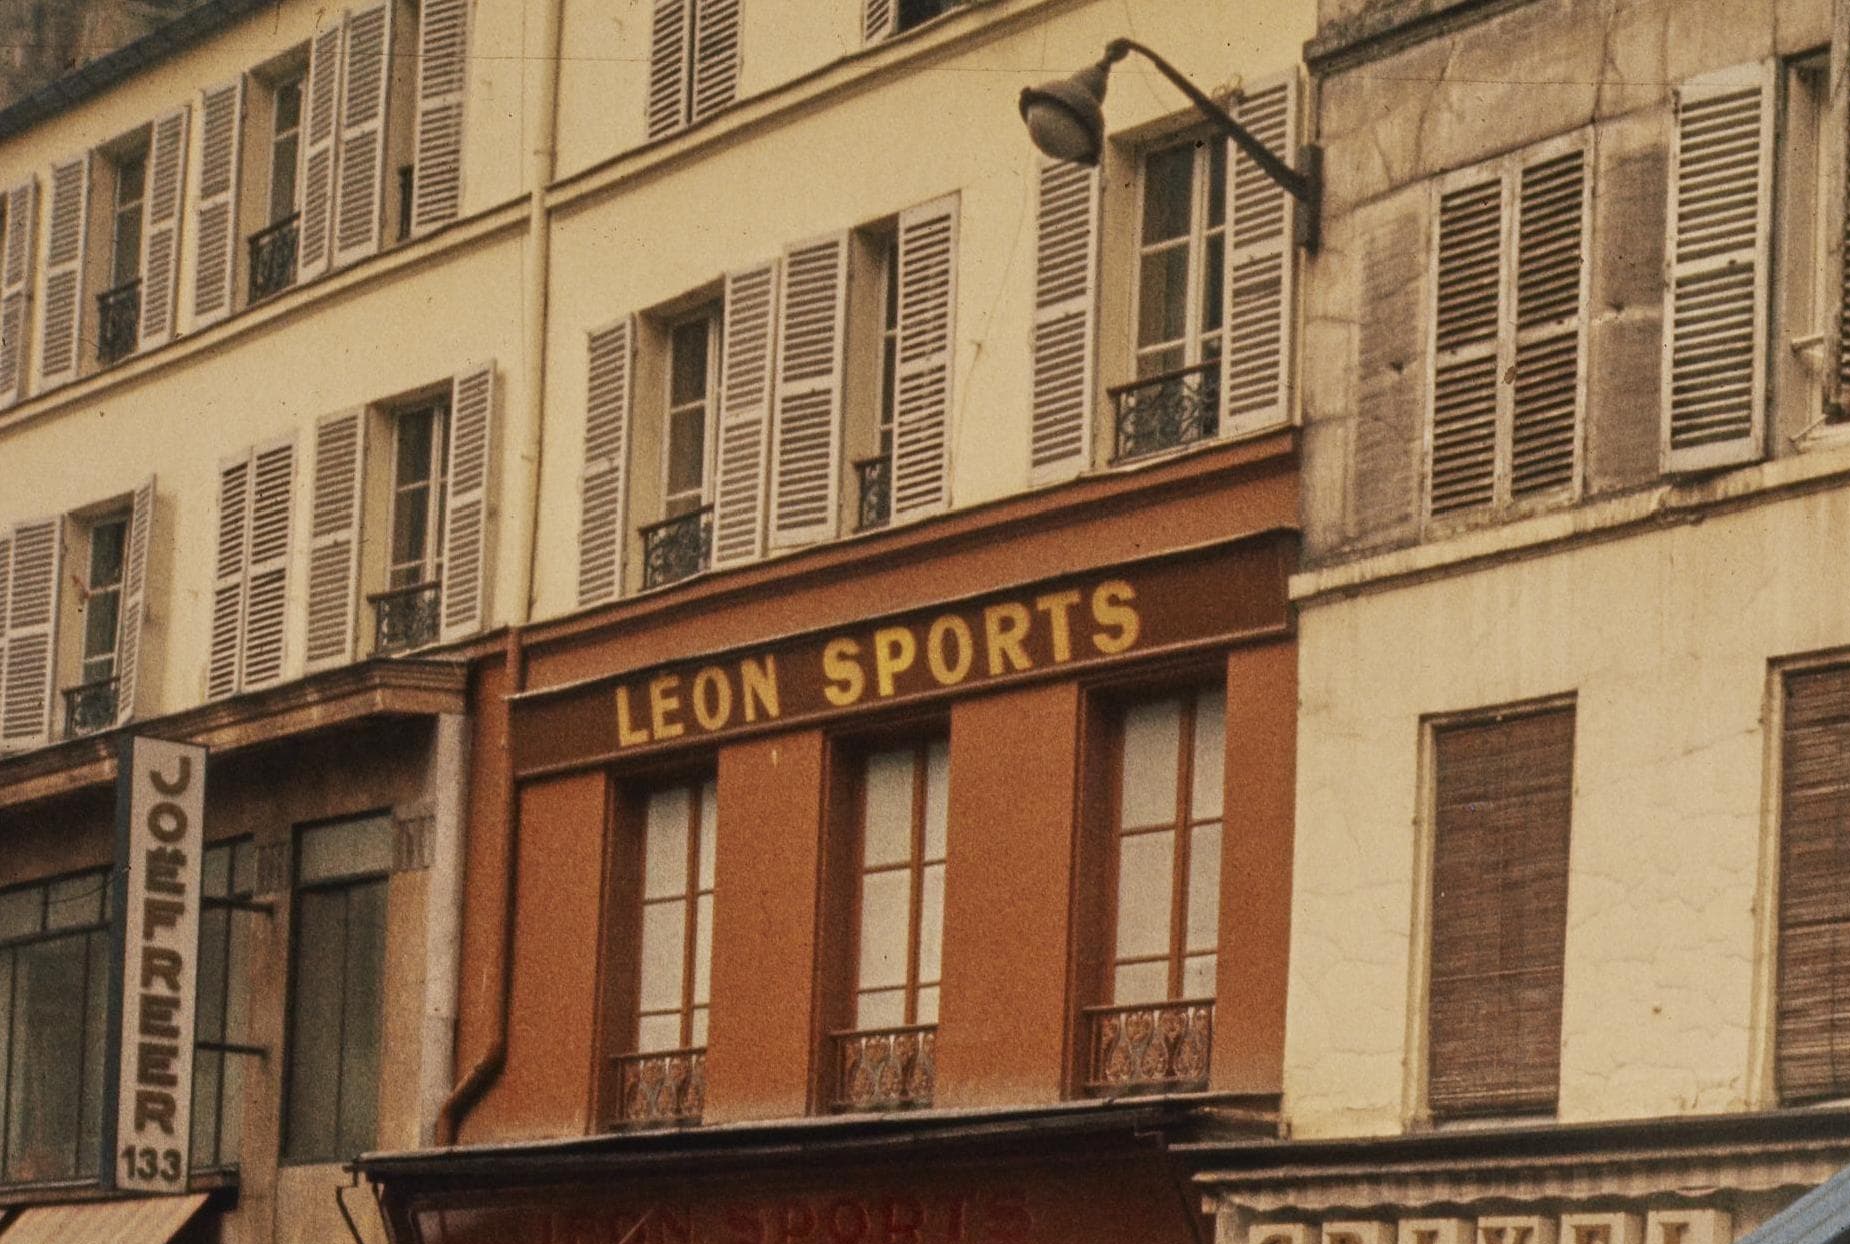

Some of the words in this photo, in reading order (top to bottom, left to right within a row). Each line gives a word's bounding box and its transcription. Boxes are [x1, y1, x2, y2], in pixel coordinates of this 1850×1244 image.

[616, 654, 782, 747] LEON
[822, 579, 1140, 706] SPORTS
[121, 1146, 181, 1183] 133
